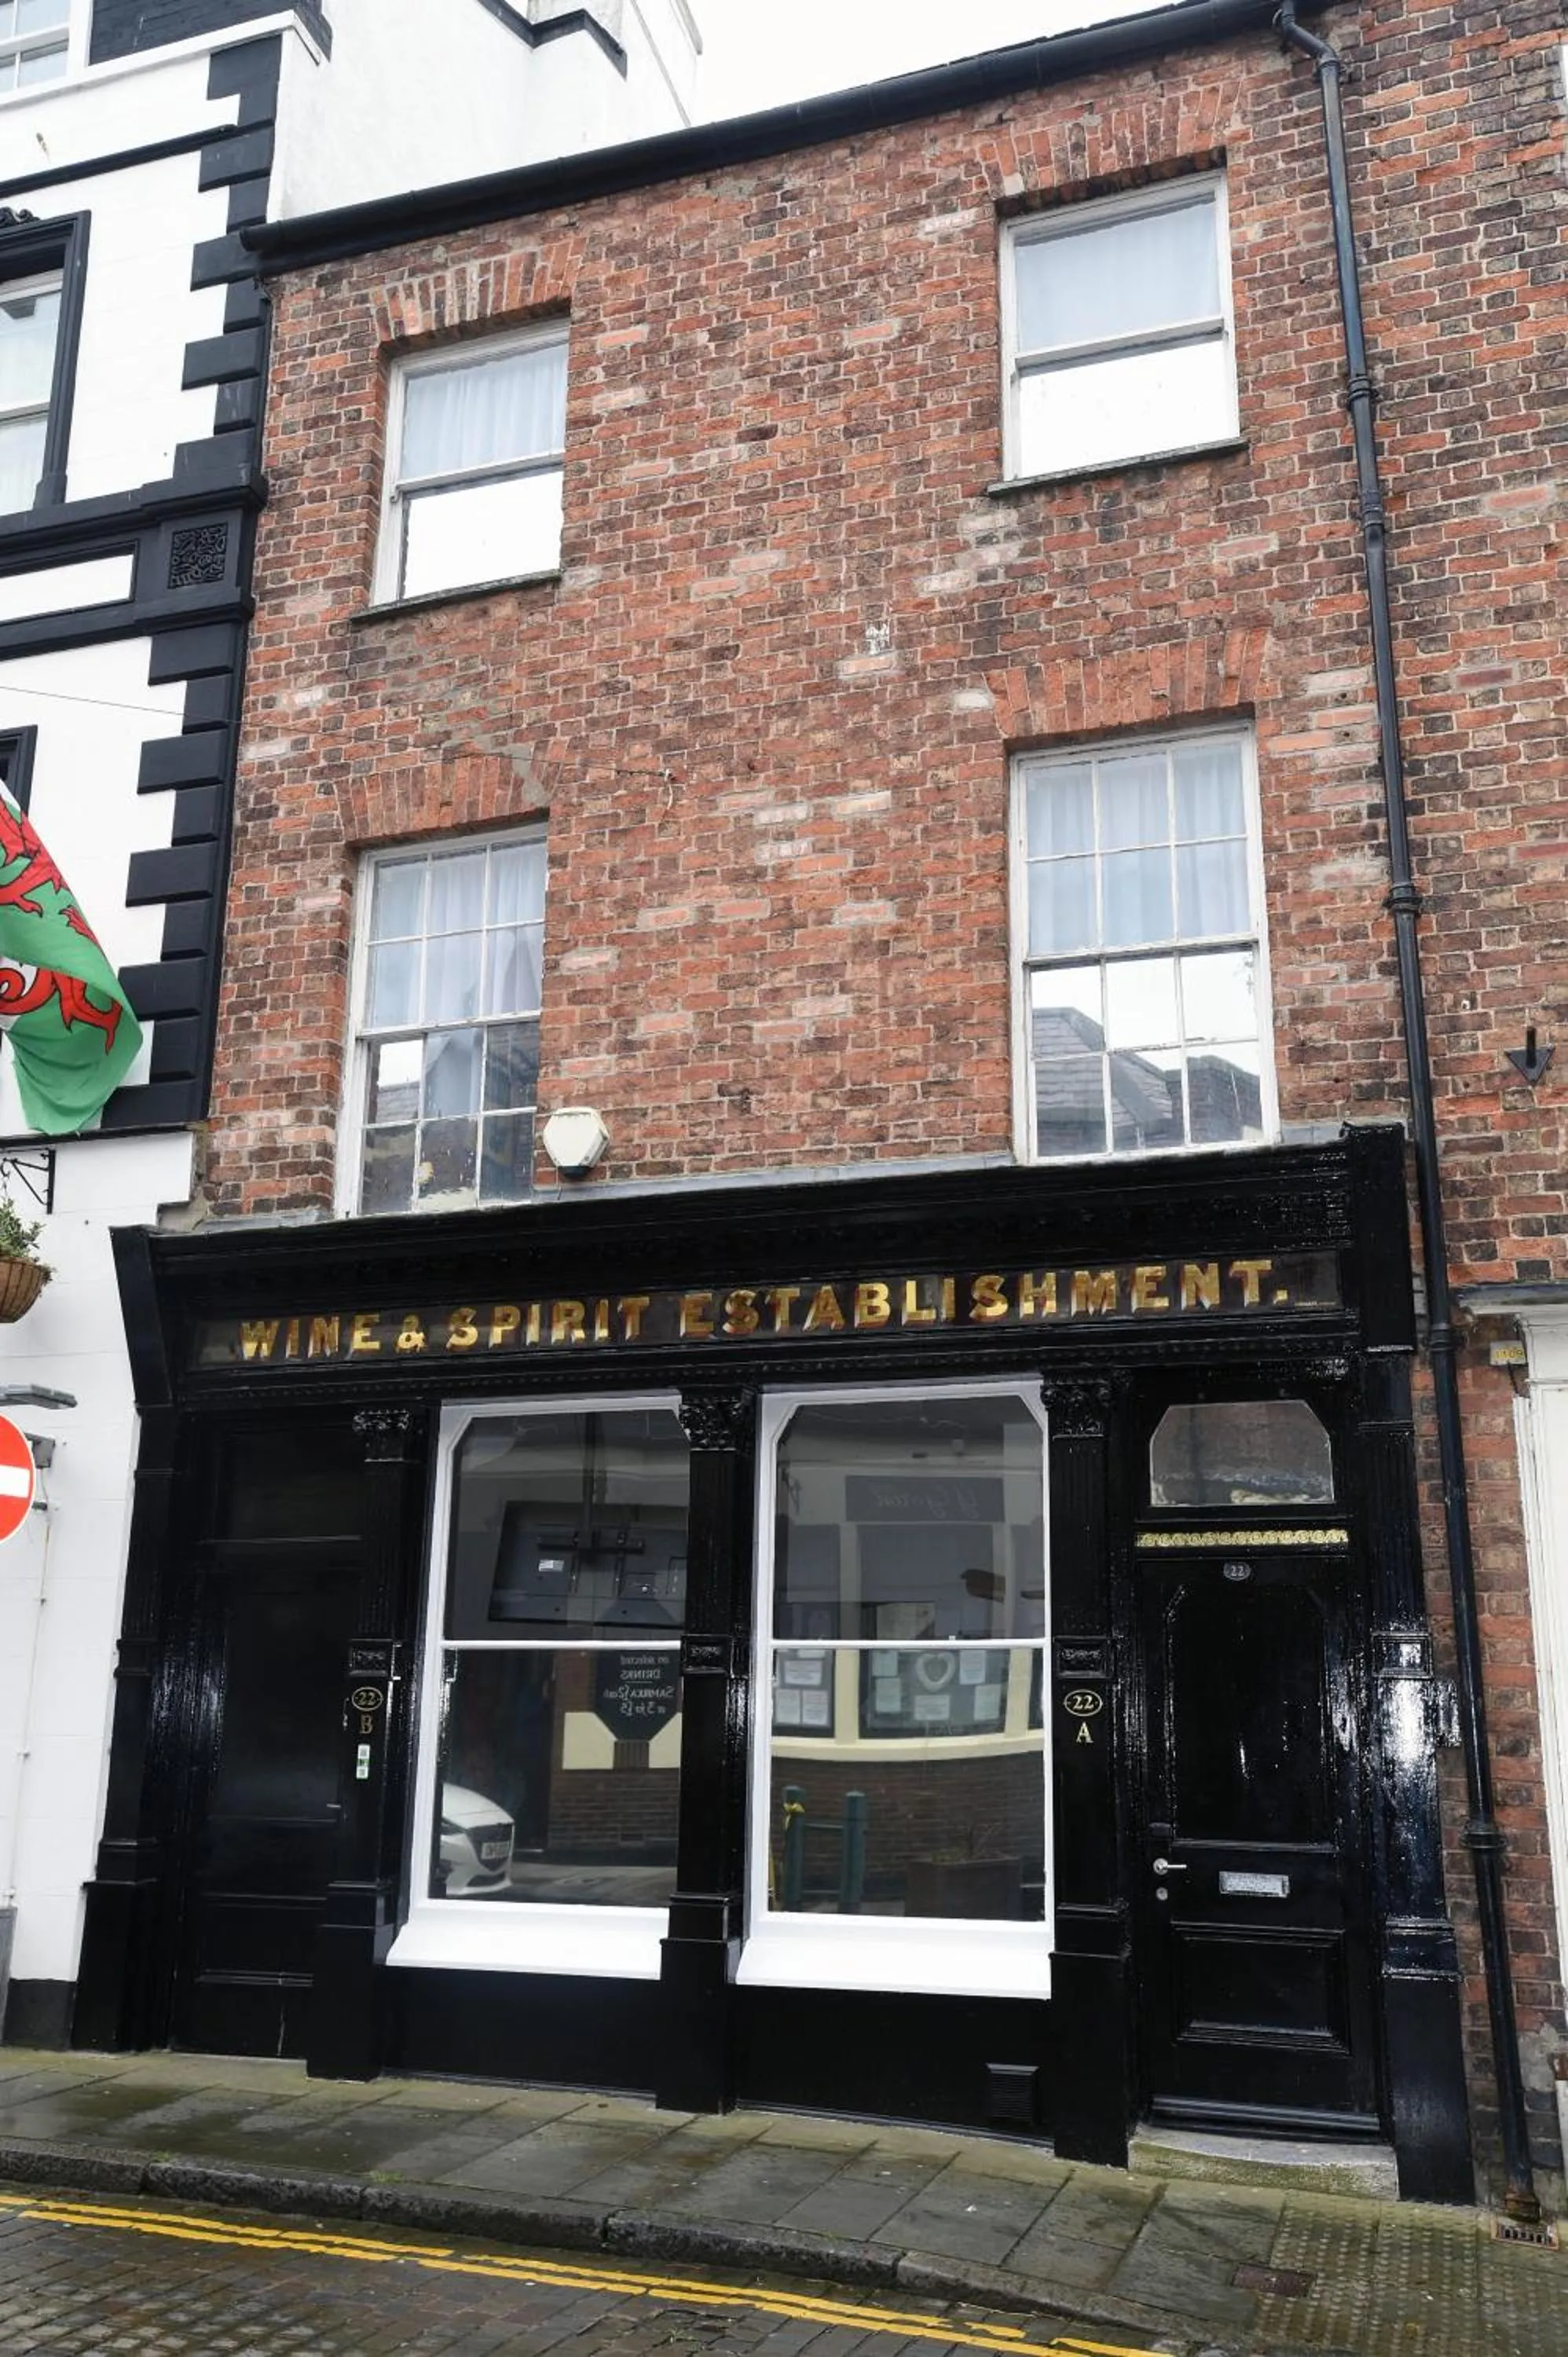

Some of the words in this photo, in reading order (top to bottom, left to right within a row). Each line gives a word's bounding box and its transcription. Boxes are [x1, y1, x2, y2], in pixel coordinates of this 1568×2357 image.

[240, 1314, 383, 1359] WINE
[396, 1314, 426, 1353] &
[445, 1296, 650, 1350] SPIRIT
[679, 1259, 1288, 1338] ESTABLISHMENT.
[1230, 1564, 1245, 1577] 22
[357, 1692, 378, 1706] 22
[1072, 1695, 1094, 1710] 22
[359, 1714, 373, 1734] B
[1075, 1721, 1094, 1743] A
